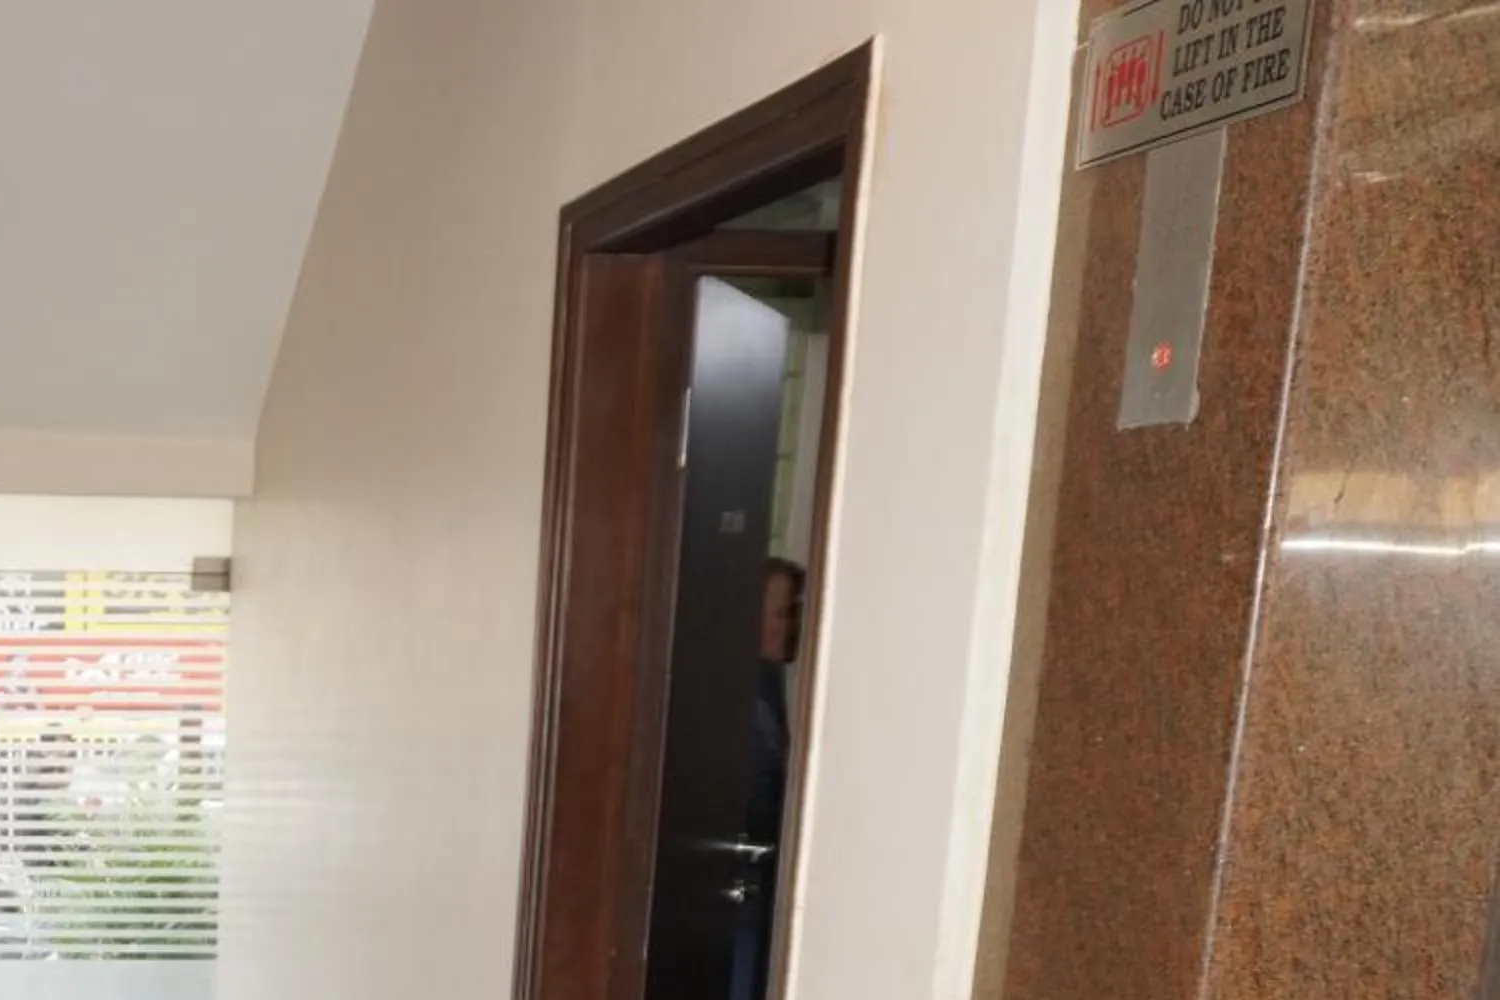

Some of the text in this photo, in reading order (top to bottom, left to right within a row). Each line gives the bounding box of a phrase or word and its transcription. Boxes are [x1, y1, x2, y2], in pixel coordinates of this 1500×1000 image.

[1173, 6, 1286, 77] LIFT IN THE
[1177, 0, 1204, 35] DO
[1160, 48, 1291, 121] CASE OF FIRE
